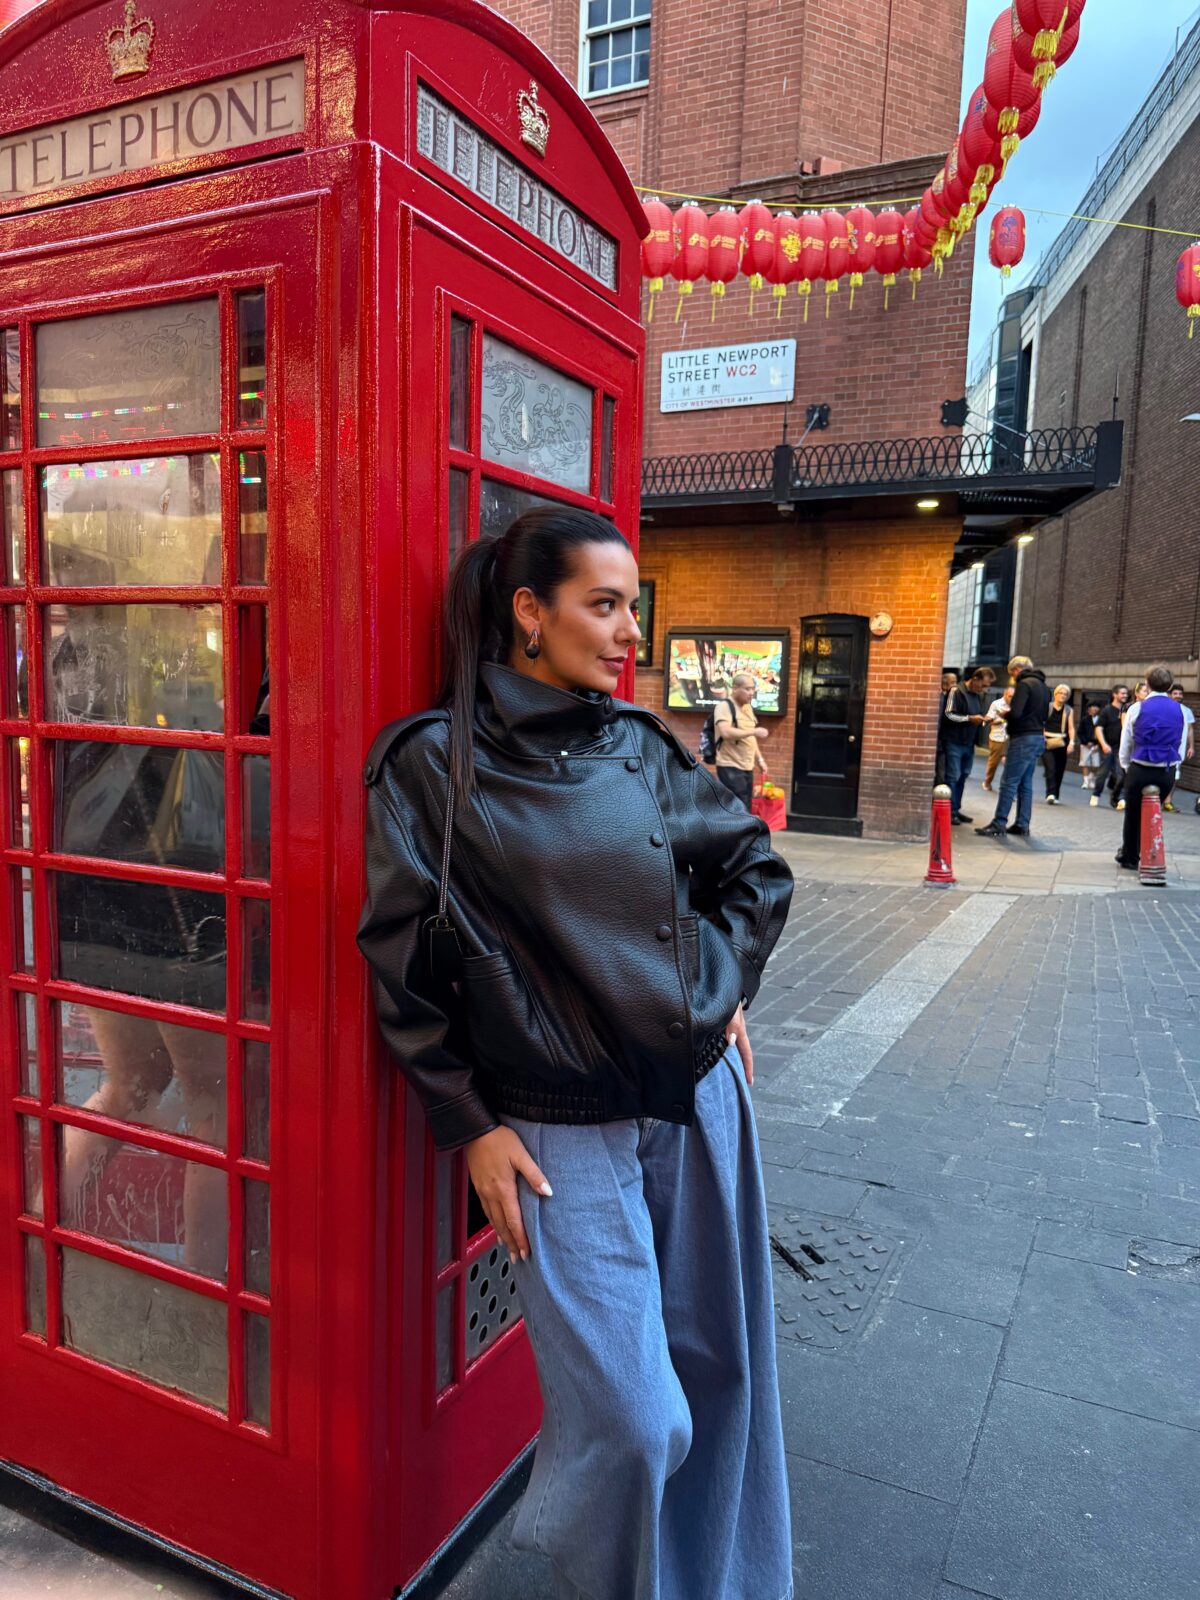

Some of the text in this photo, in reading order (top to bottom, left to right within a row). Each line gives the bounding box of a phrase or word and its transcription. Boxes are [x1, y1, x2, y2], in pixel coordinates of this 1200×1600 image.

[1, 72, 294, 194] TELEPHONE
[420, 97, 610, 284] TELEPHONE
[668, 345, 789, 369] LITTLE NEWPORT
[668, 364, 757, 384] STREET WC2
[665, 402, 679, 410] CITY
[690, 397, 736, 407] WESTMINSTER
